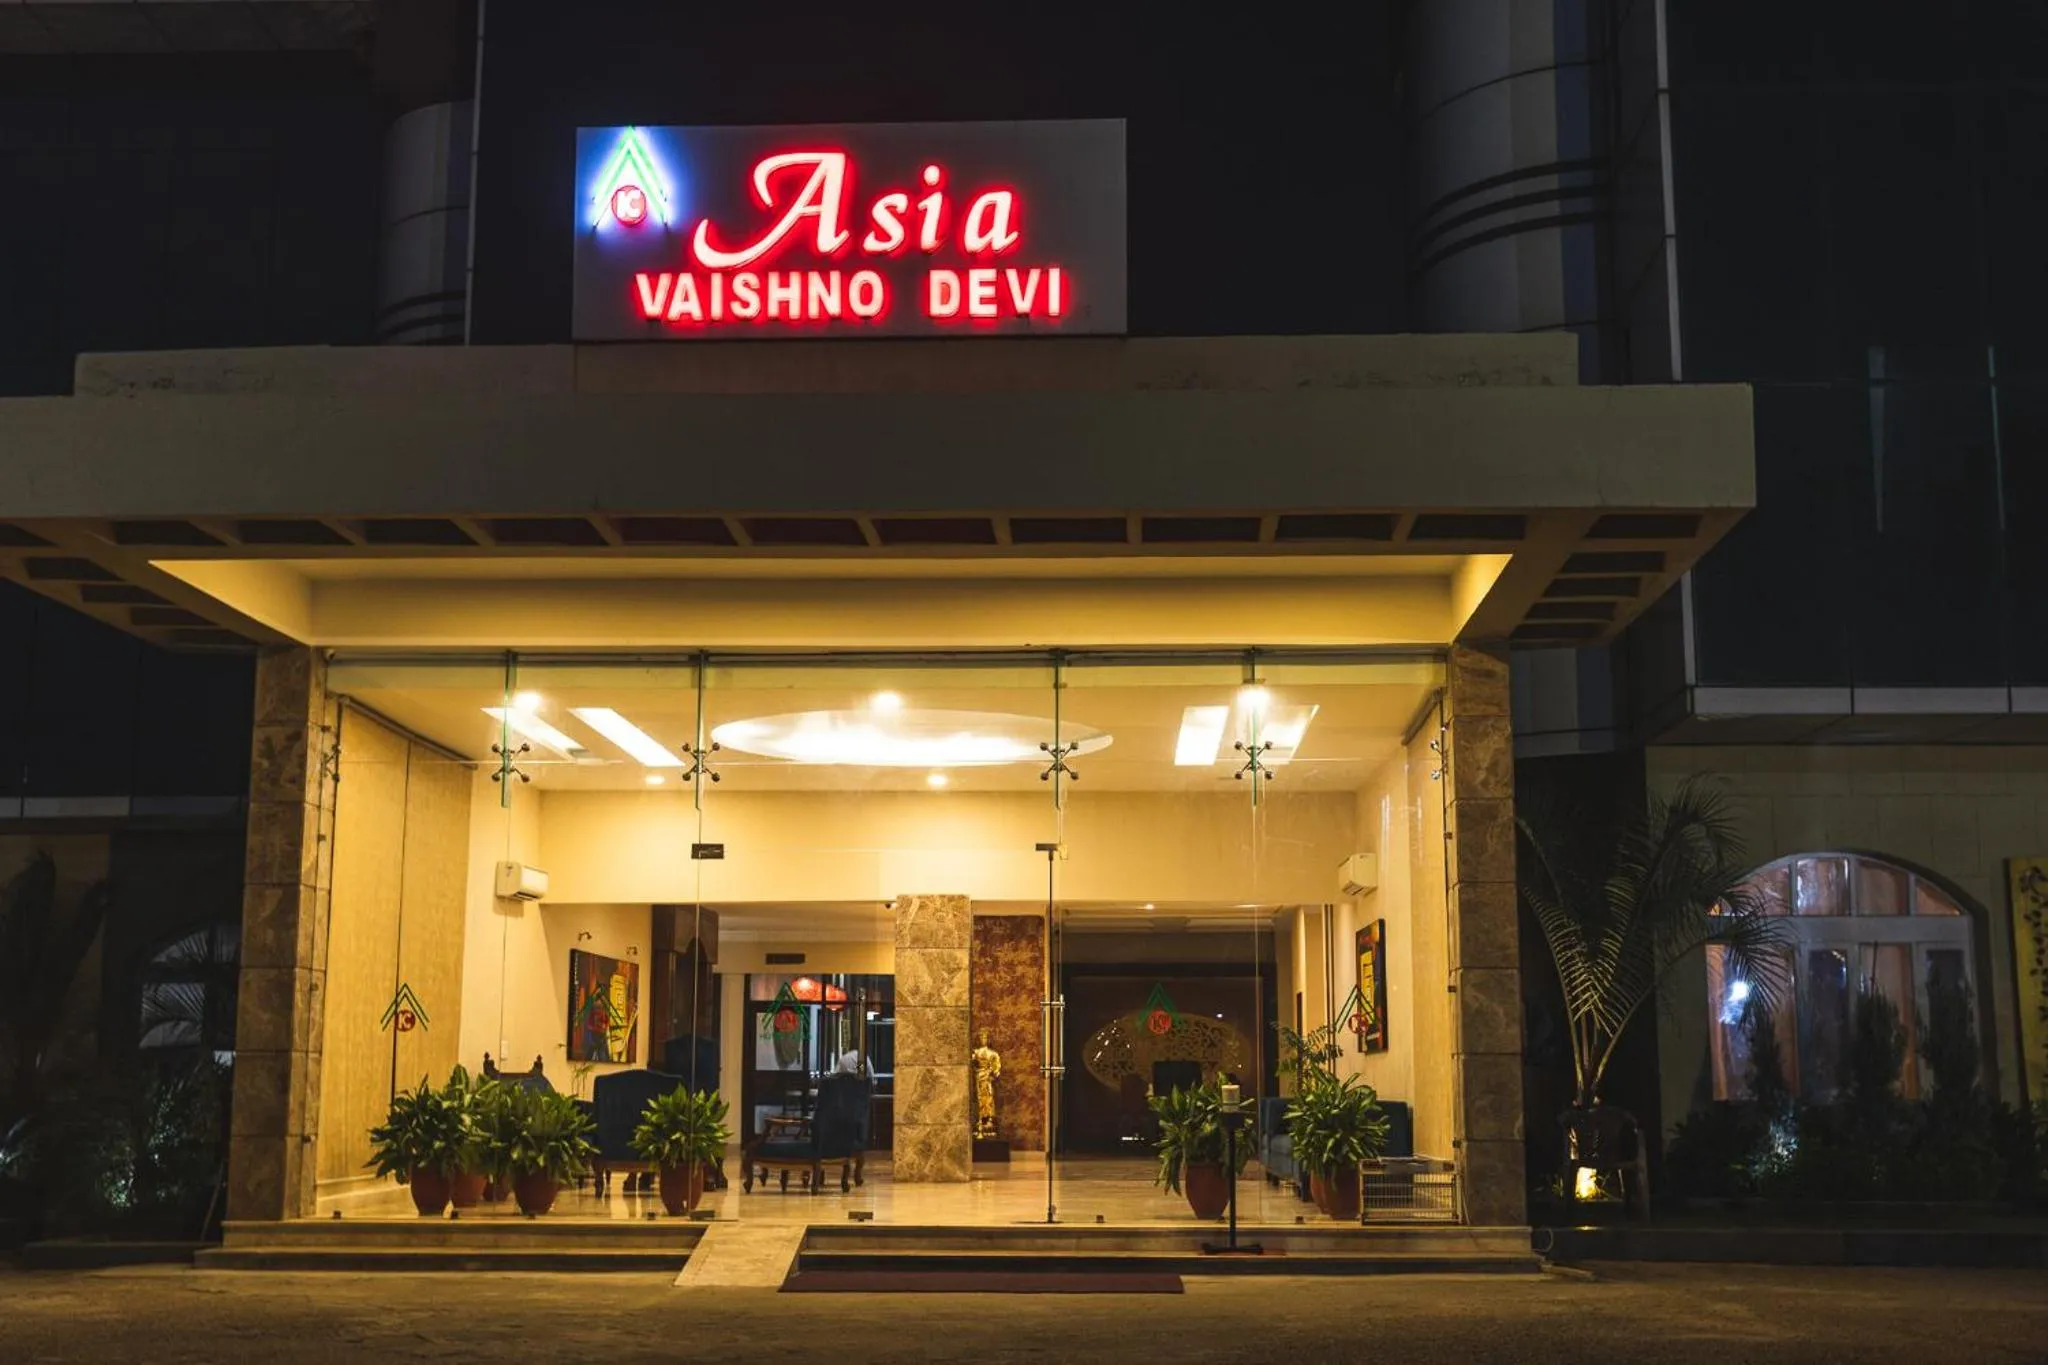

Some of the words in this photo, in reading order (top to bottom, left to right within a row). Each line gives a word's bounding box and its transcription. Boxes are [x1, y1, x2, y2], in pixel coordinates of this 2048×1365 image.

[693, 151, 1020, 269] Asia
[634, 270, 886, 321] VAISHNO
[928, 267, 1063, 319] DEVI
